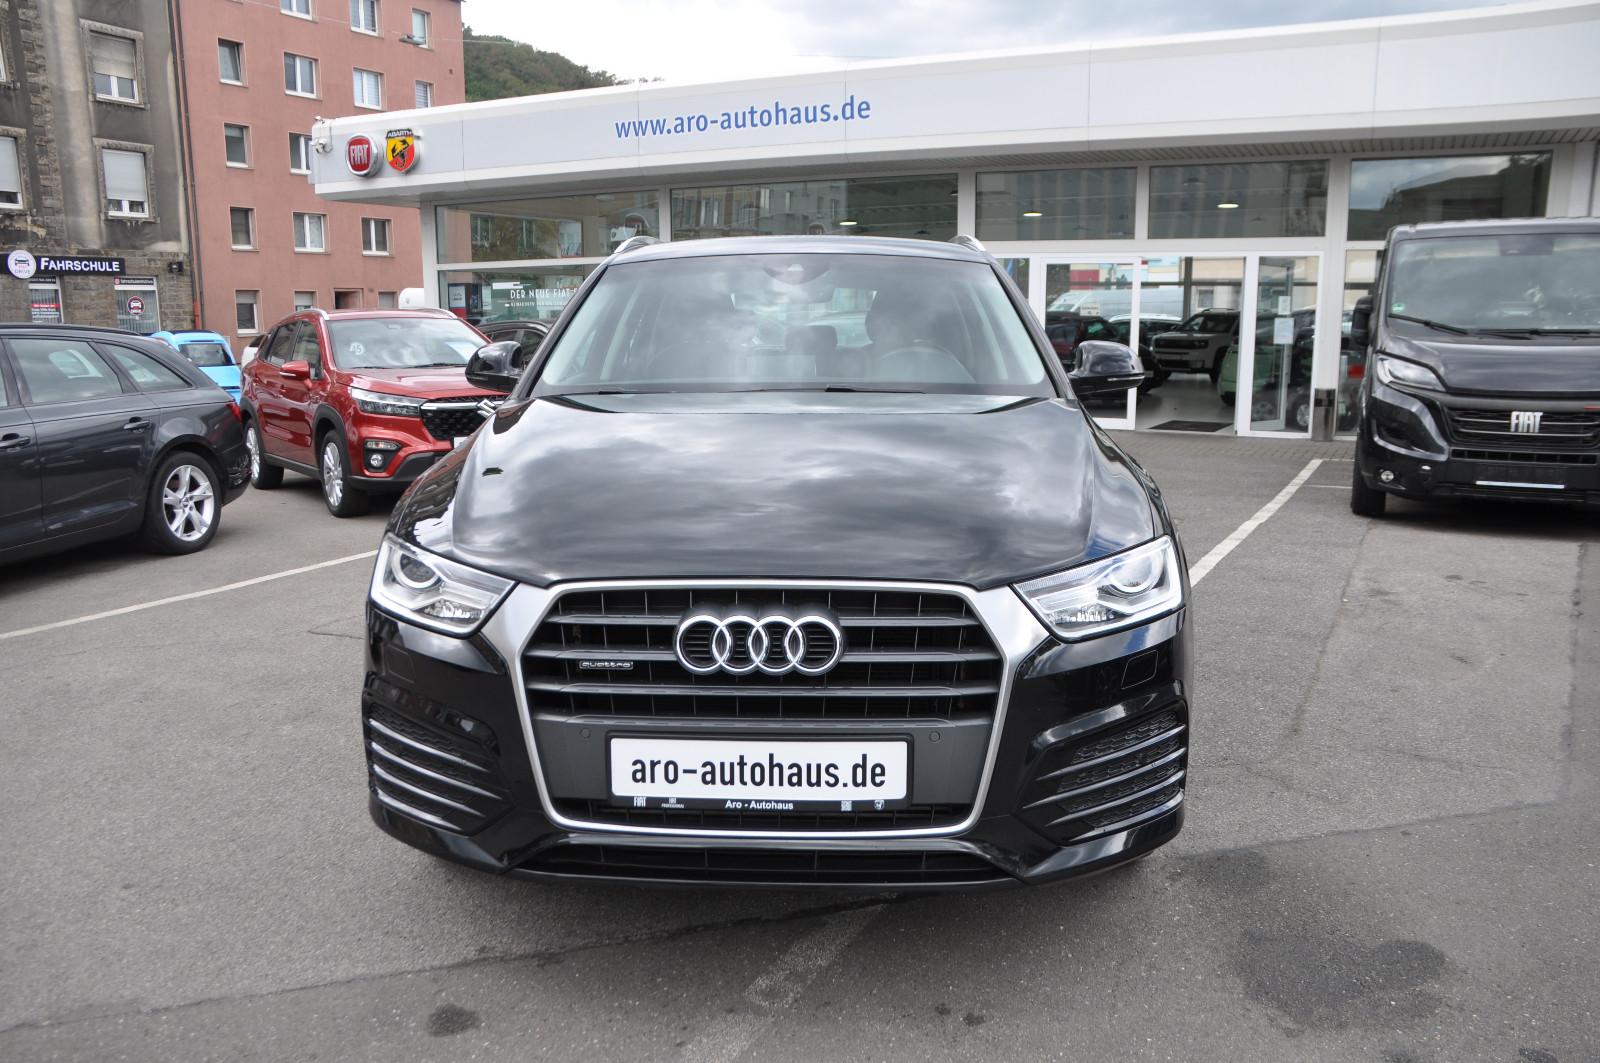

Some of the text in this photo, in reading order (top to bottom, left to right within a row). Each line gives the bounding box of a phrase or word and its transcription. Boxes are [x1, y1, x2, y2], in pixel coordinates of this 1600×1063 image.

[615, 95, 871, 138] www.aro-autohaus.de
[350, 145, 368, 165] FIAT
[40, 257, 120, 272] FAHRSCHULE
[510, 289, 526, 299] DER
[528, 288, 550, 299] NEUE
[1510, 411, 1543, 433] FIAT
[631, 752, 886, 788] aro-autohaus.de
[633, 796, 647, 807] FIAT
[725, 799, 743, 809] Aro
[749, 800, 794, 810] Autohaus
